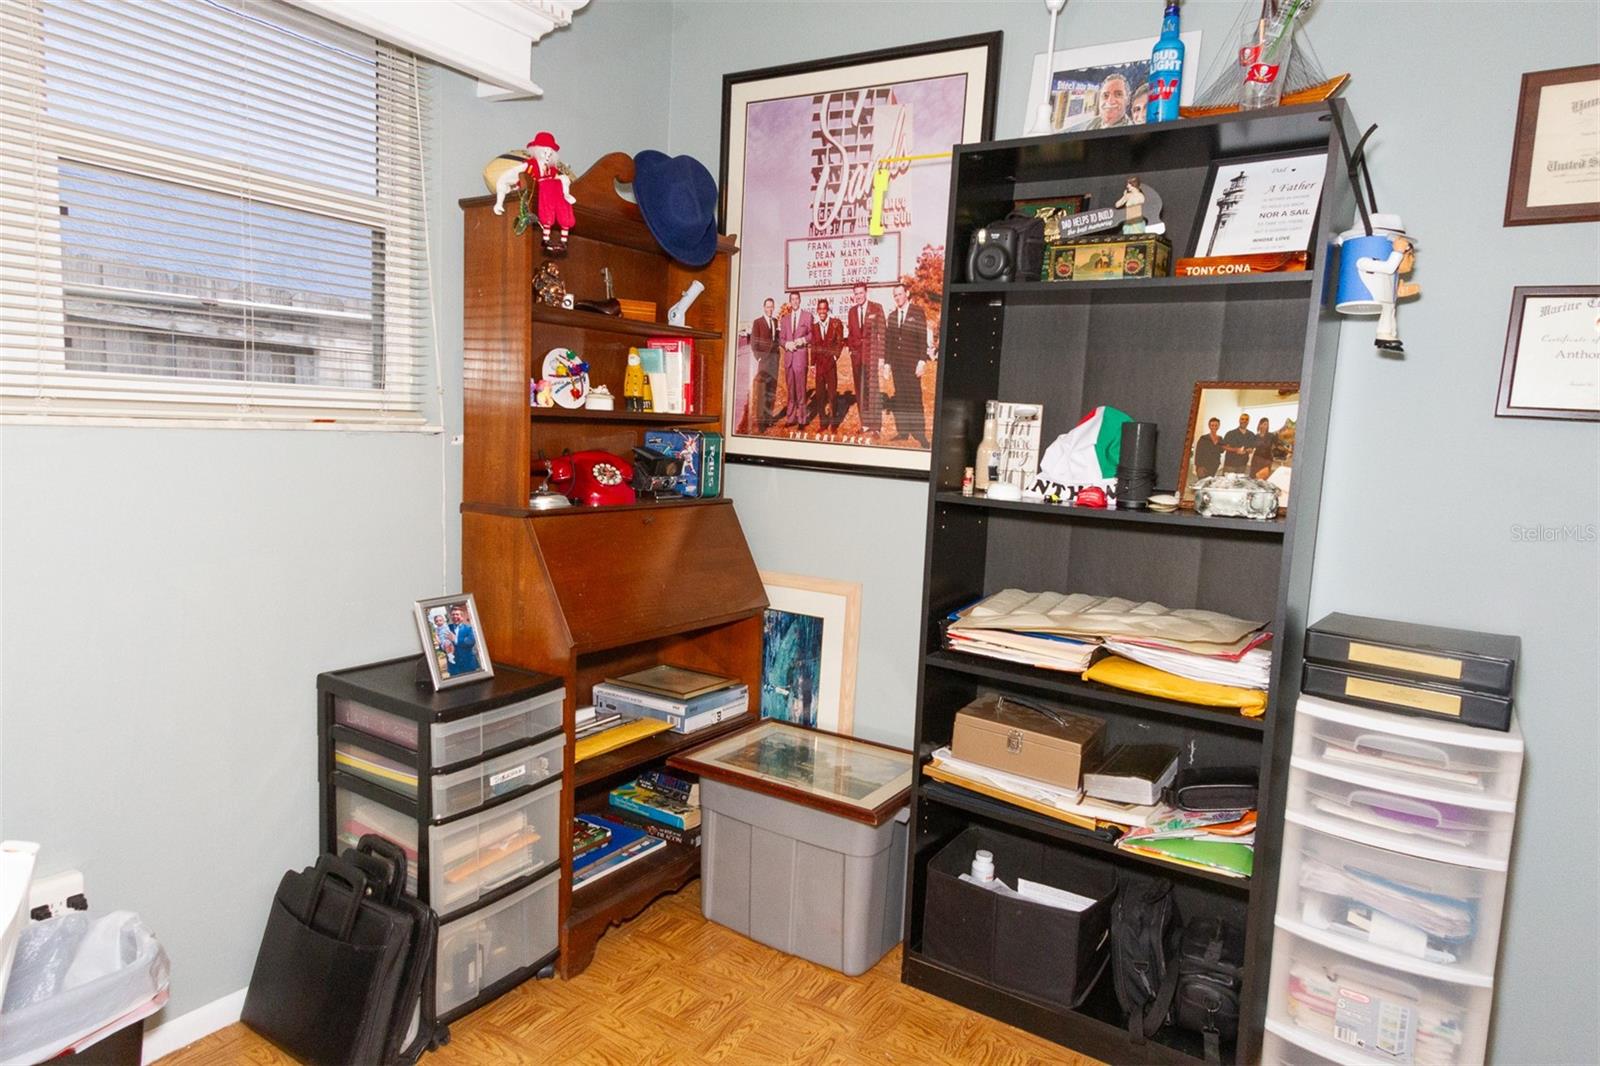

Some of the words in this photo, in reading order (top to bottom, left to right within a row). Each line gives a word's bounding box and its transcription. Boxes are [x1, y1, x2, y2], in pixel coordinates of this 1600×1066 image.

[1152, 48, 1179, 63] BUD
[1149, 60, 1183, 75] LIGHT
[1278, 180, 1317, 192] Father
[1072, 212, 1090, 227] HELPS
[1258, 211, 1279, 219] NOR
[1289, 209, 1311, 217] SAIL
[807, 241, 833, 251] FRANK
[842, 238, 880, 249] SINATRA
[815, 250, 836, 260] DEAN
[840, 248, 871, 258] MARTIN
[807, 260, 833, 270] SAMMY
[843, 258, 866, 267] DAVIS
[870, 256, 880, 265] JR
[1185, 265, 1216, 276] TONY
[1216, 263, 1252, 275] CONA
[808, 269, 833, 279] PETER
[841, 266, 878, 277] LAWFORD
[841, 276, 872, 285] BISHOP
